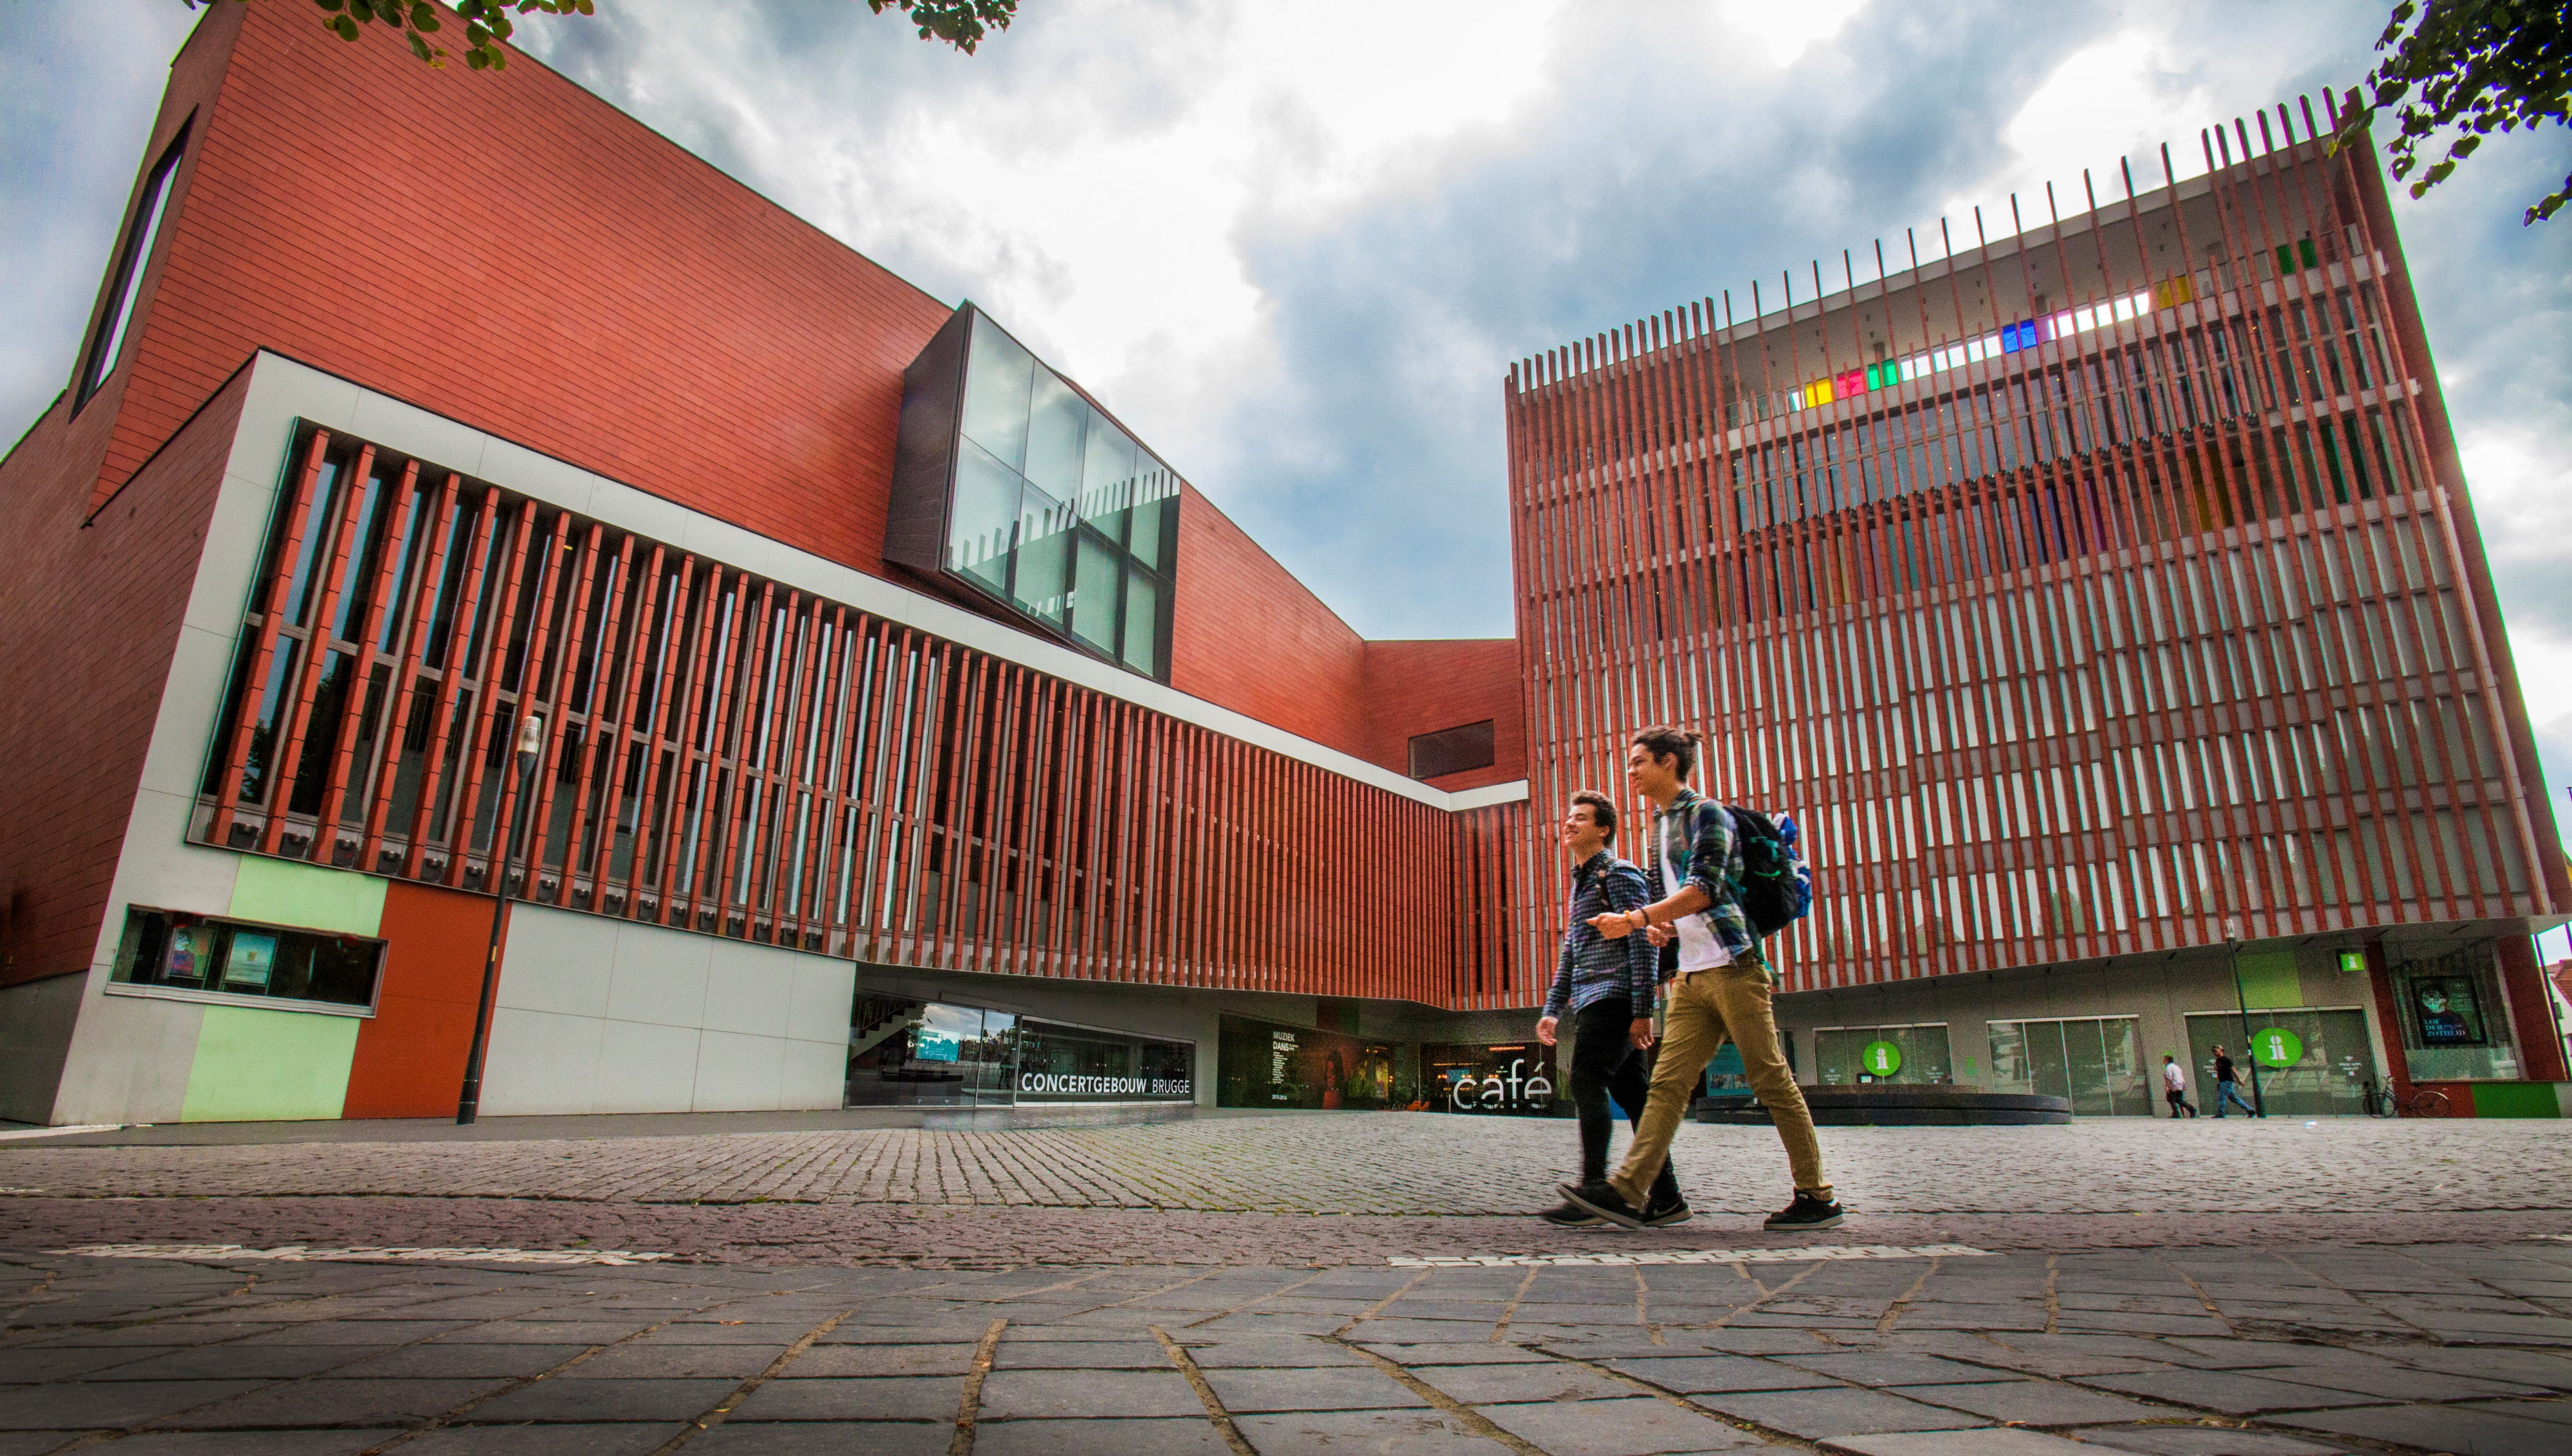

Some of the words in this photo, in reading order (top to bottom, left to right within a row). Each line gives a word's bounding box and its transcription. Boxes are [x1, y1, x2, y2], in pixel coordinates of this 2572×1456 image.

[1273, 1030, 1295, 1042] MUZIEK
[1273, 1041, 1289, 1052] DANS
[1022, 1073, 1146, 1093] CONCERTGEBOUW
[1152, 1079, 1190, 1093] BRUGGE
[1453, 1059, 1552, 1110] café
